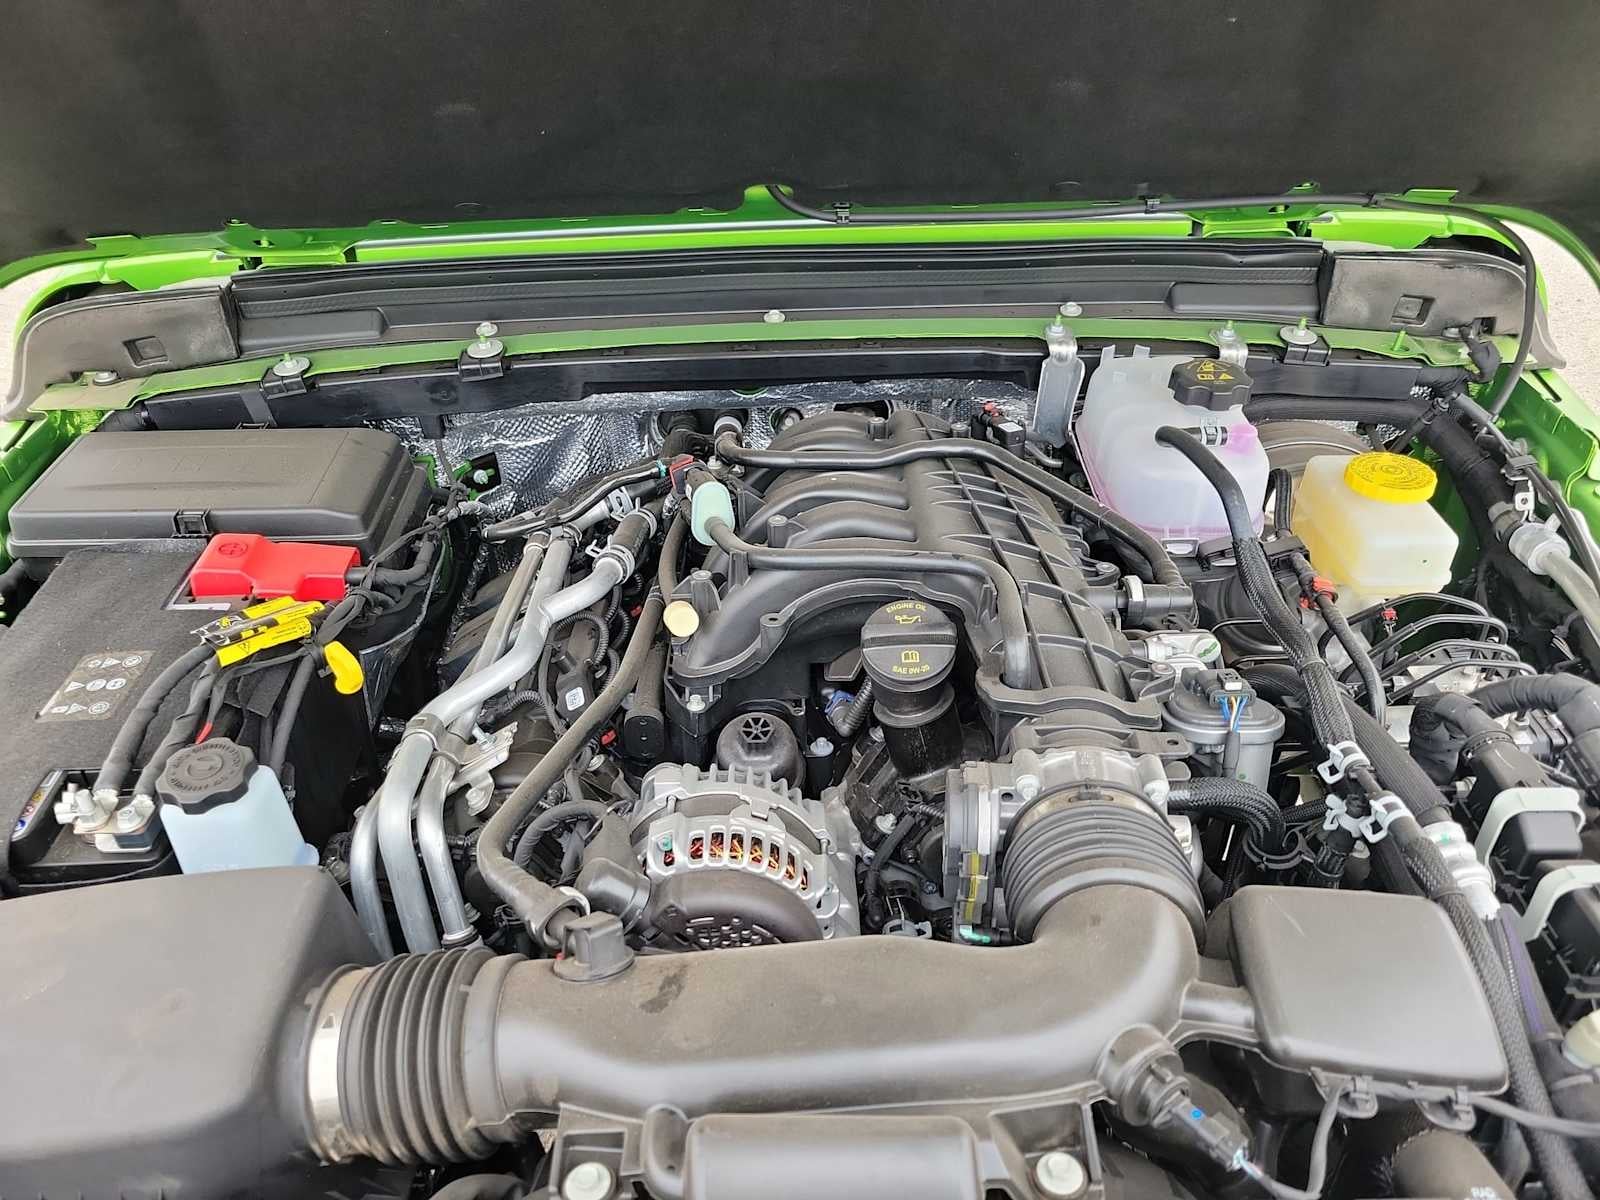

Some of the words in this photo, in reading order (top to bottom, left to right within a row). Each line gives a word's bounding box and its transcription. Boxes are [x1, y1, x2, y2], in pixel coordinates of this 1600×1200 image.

[886, 602, 914, 613] ENGINE
[915, 603, 928, 612] OIL
[892, 665, 907, 675] SAE
